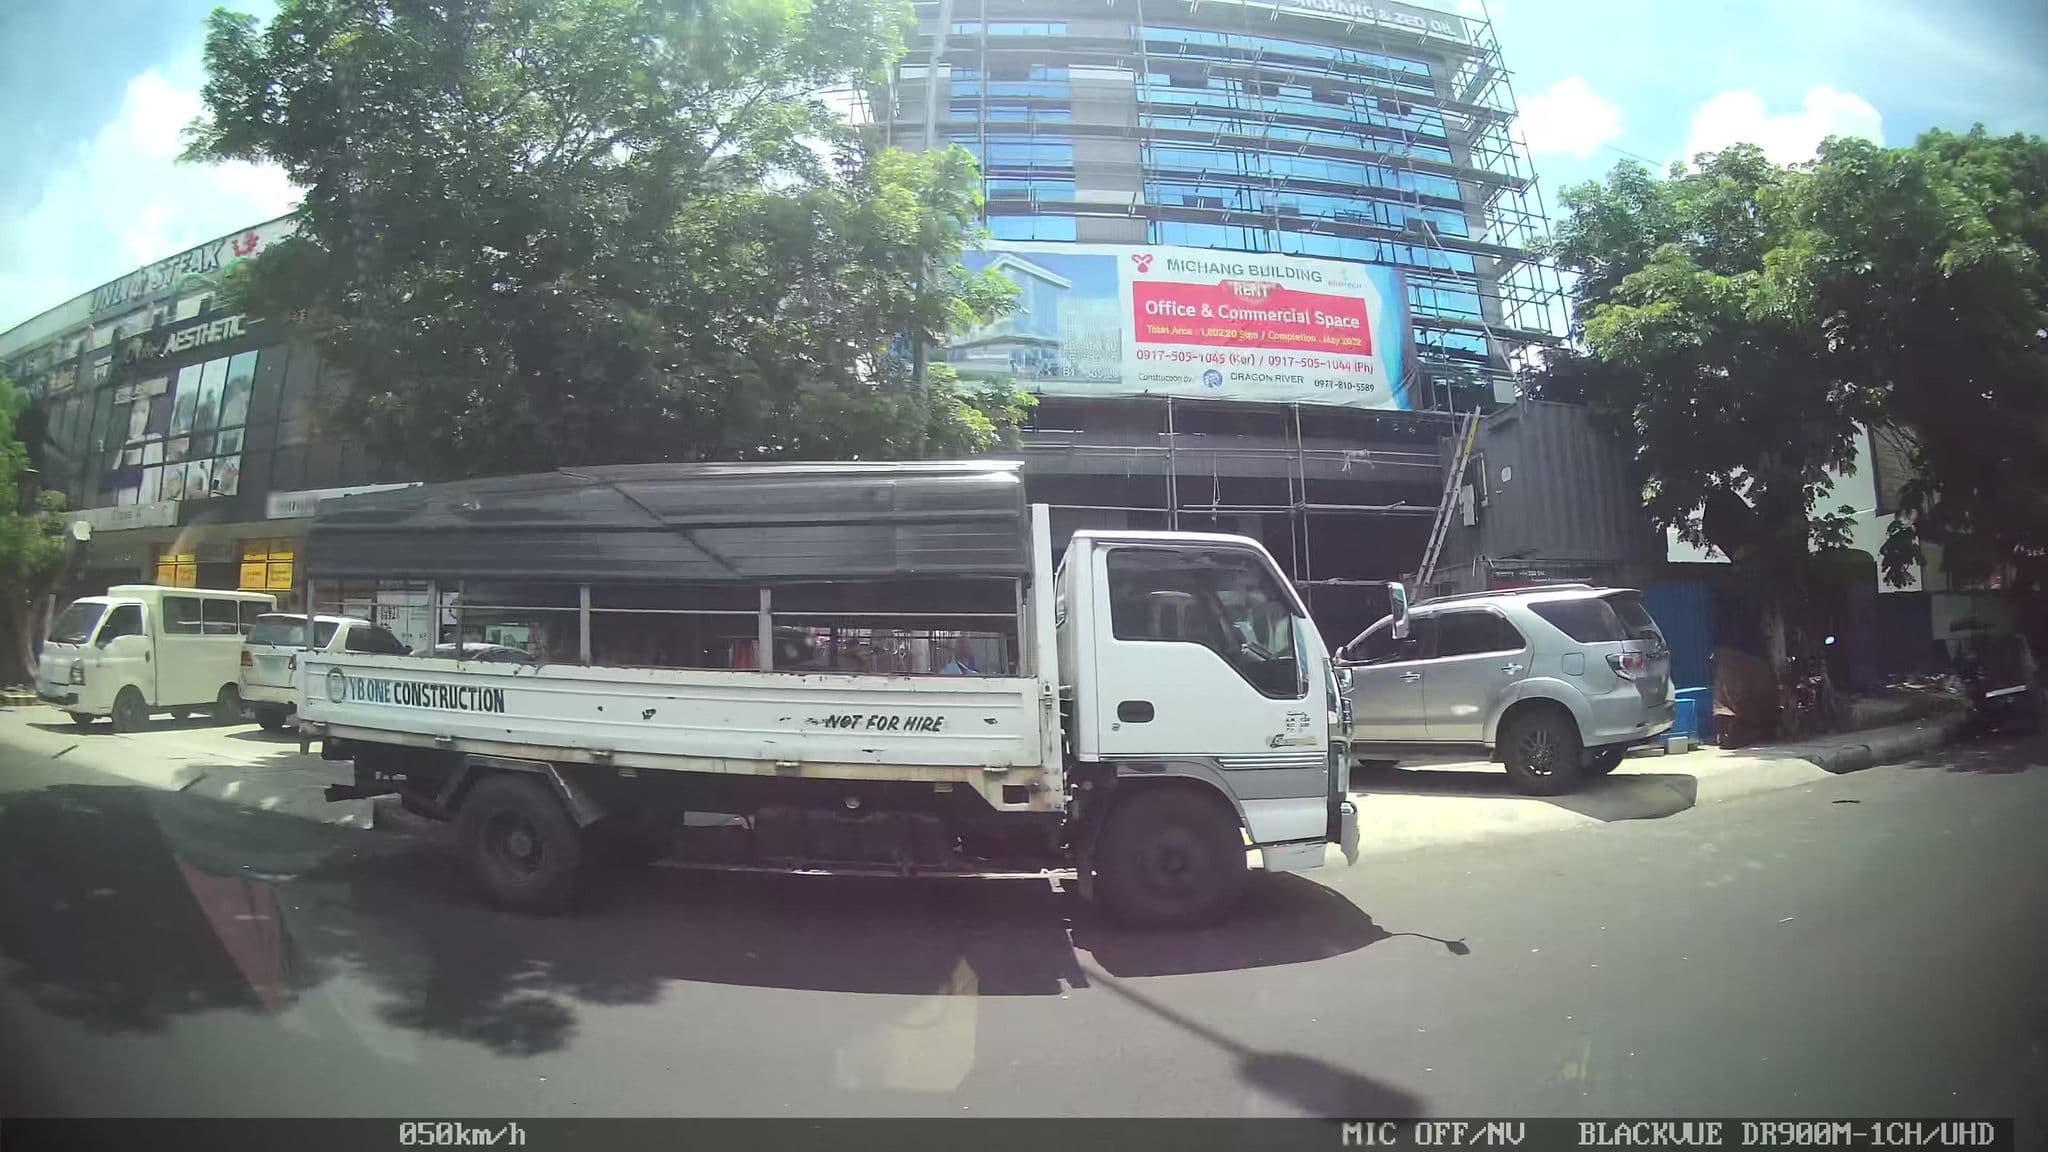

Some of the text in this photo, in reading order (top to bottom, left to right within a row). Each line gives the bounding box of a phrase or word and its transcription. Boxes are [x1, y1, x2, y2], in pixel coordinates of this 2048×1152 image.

[1167, 258, 1322, 282] MICHANG BUILDING
[1234, 283, 1268, 297] RENT
[1145, 301, 1360, 329] Office & Commercial Space
[1268, 331, 1317, 344] Completion
[1229, 353, 1255, 367] (Kor)
[1268, 355, 1351, 370] 0917-505-1044
[1354, 361, 1374, 375] (Ph)
[1230, 372, 1305, 384] DRAGON RIVER
[367, 678, 391, 703] ONE
[393, 682, 505, 713] CONSTRUCTION
[825, 714, 944, 732] NOT FOR HIRE
